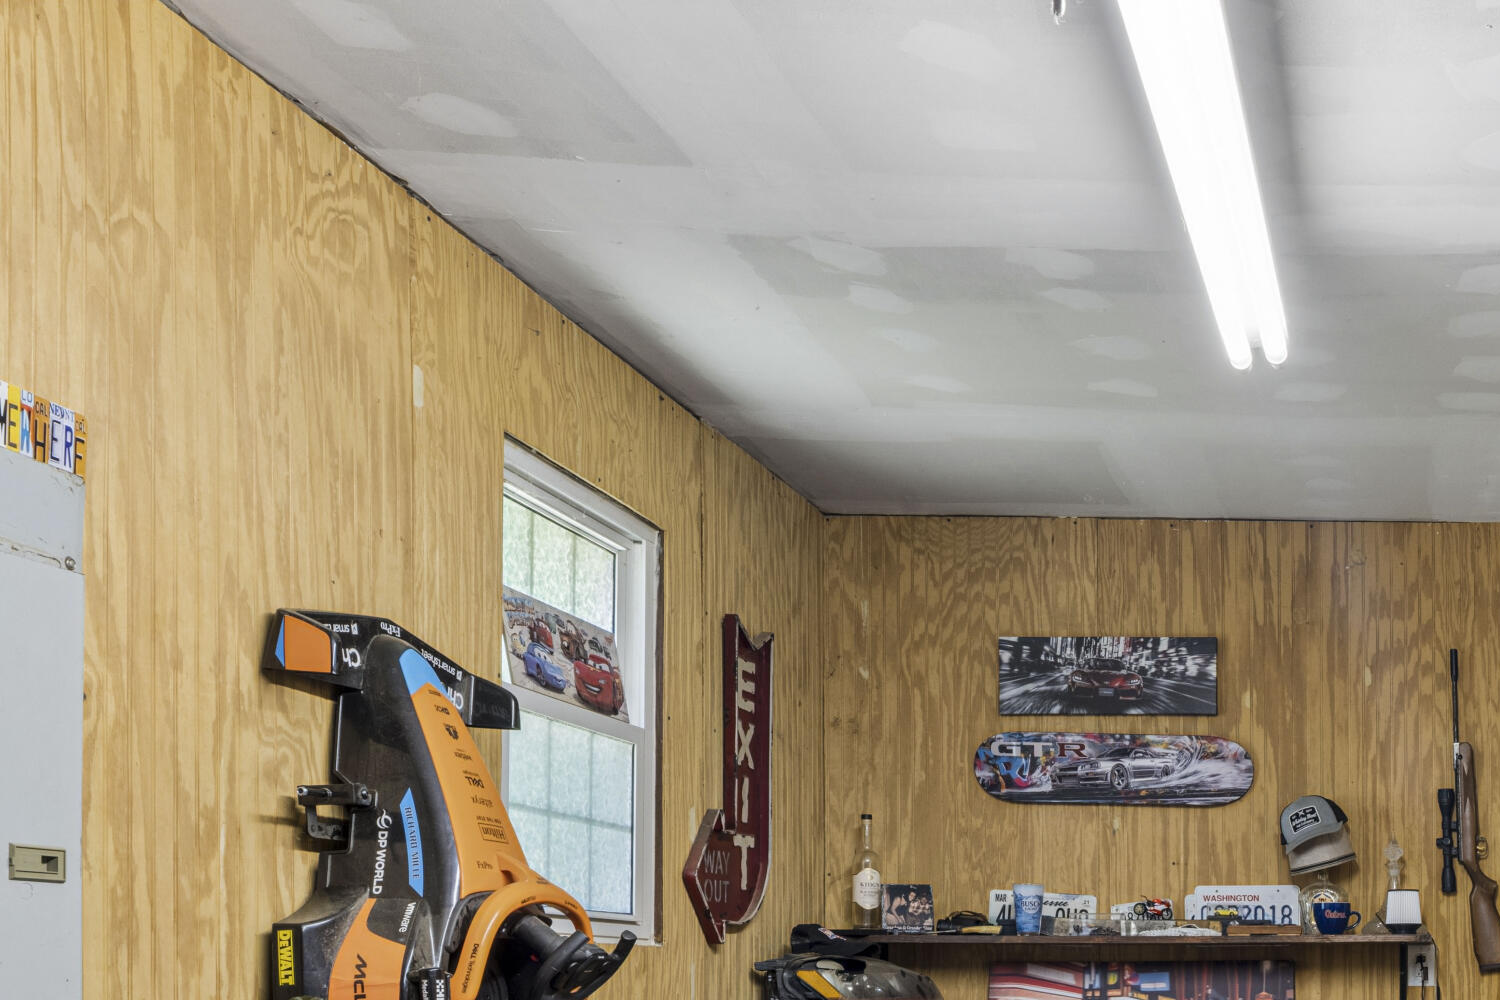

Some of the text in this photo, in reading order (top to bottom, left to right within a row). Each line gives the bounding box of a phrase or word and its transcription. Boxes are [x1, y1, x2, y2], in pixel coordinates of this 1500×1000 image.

[736, 657, 757, 890] EXIT
[373, 831, 388, 894] DP WORLD
[704, 851, 730, 875] WAY
[704, 878, 730, 905] OUT
[995, 893, 1007, 902] MAR
[1203, 894, 1260, 903] WASHINGTON
